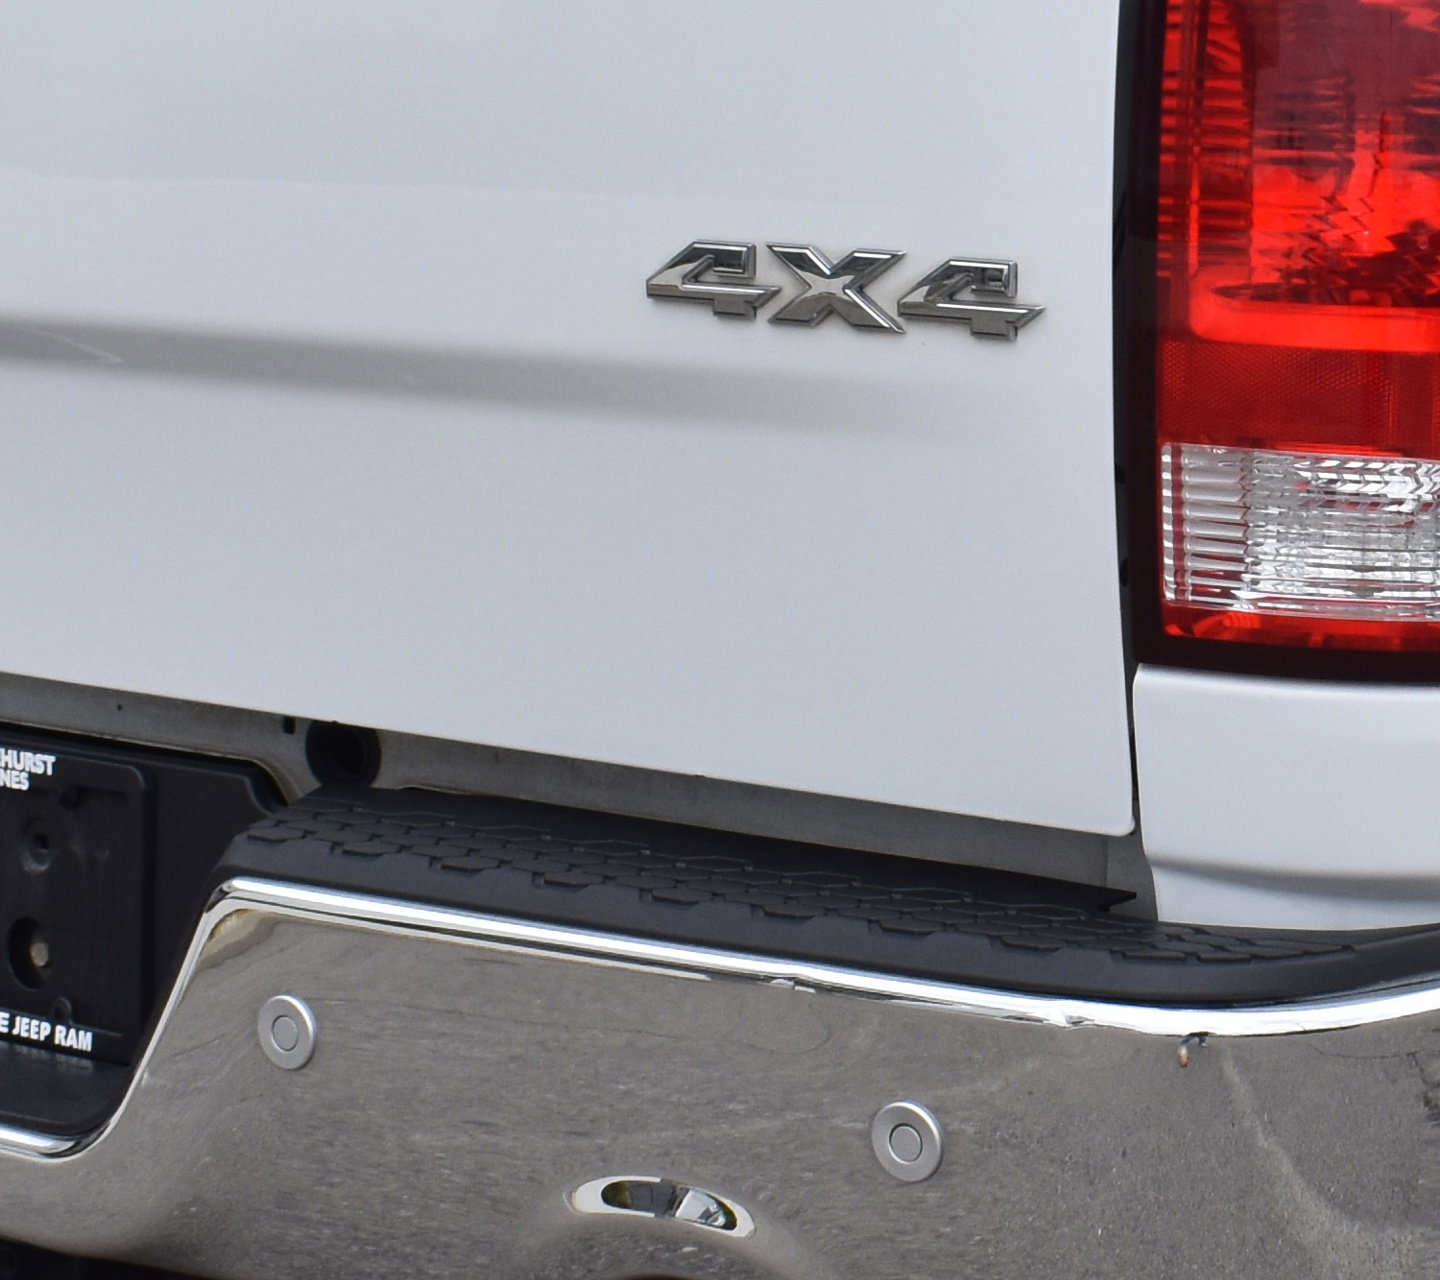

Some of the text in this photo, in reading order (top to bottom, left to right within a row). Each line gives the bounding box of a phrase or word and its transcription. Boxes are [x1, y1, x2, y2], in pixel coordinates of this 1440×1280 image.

[645, 238, 1048, 343] 4X4
[12, 1015, 51, 1042] JEEP
[54, 1024, 93, 1052] RAM
